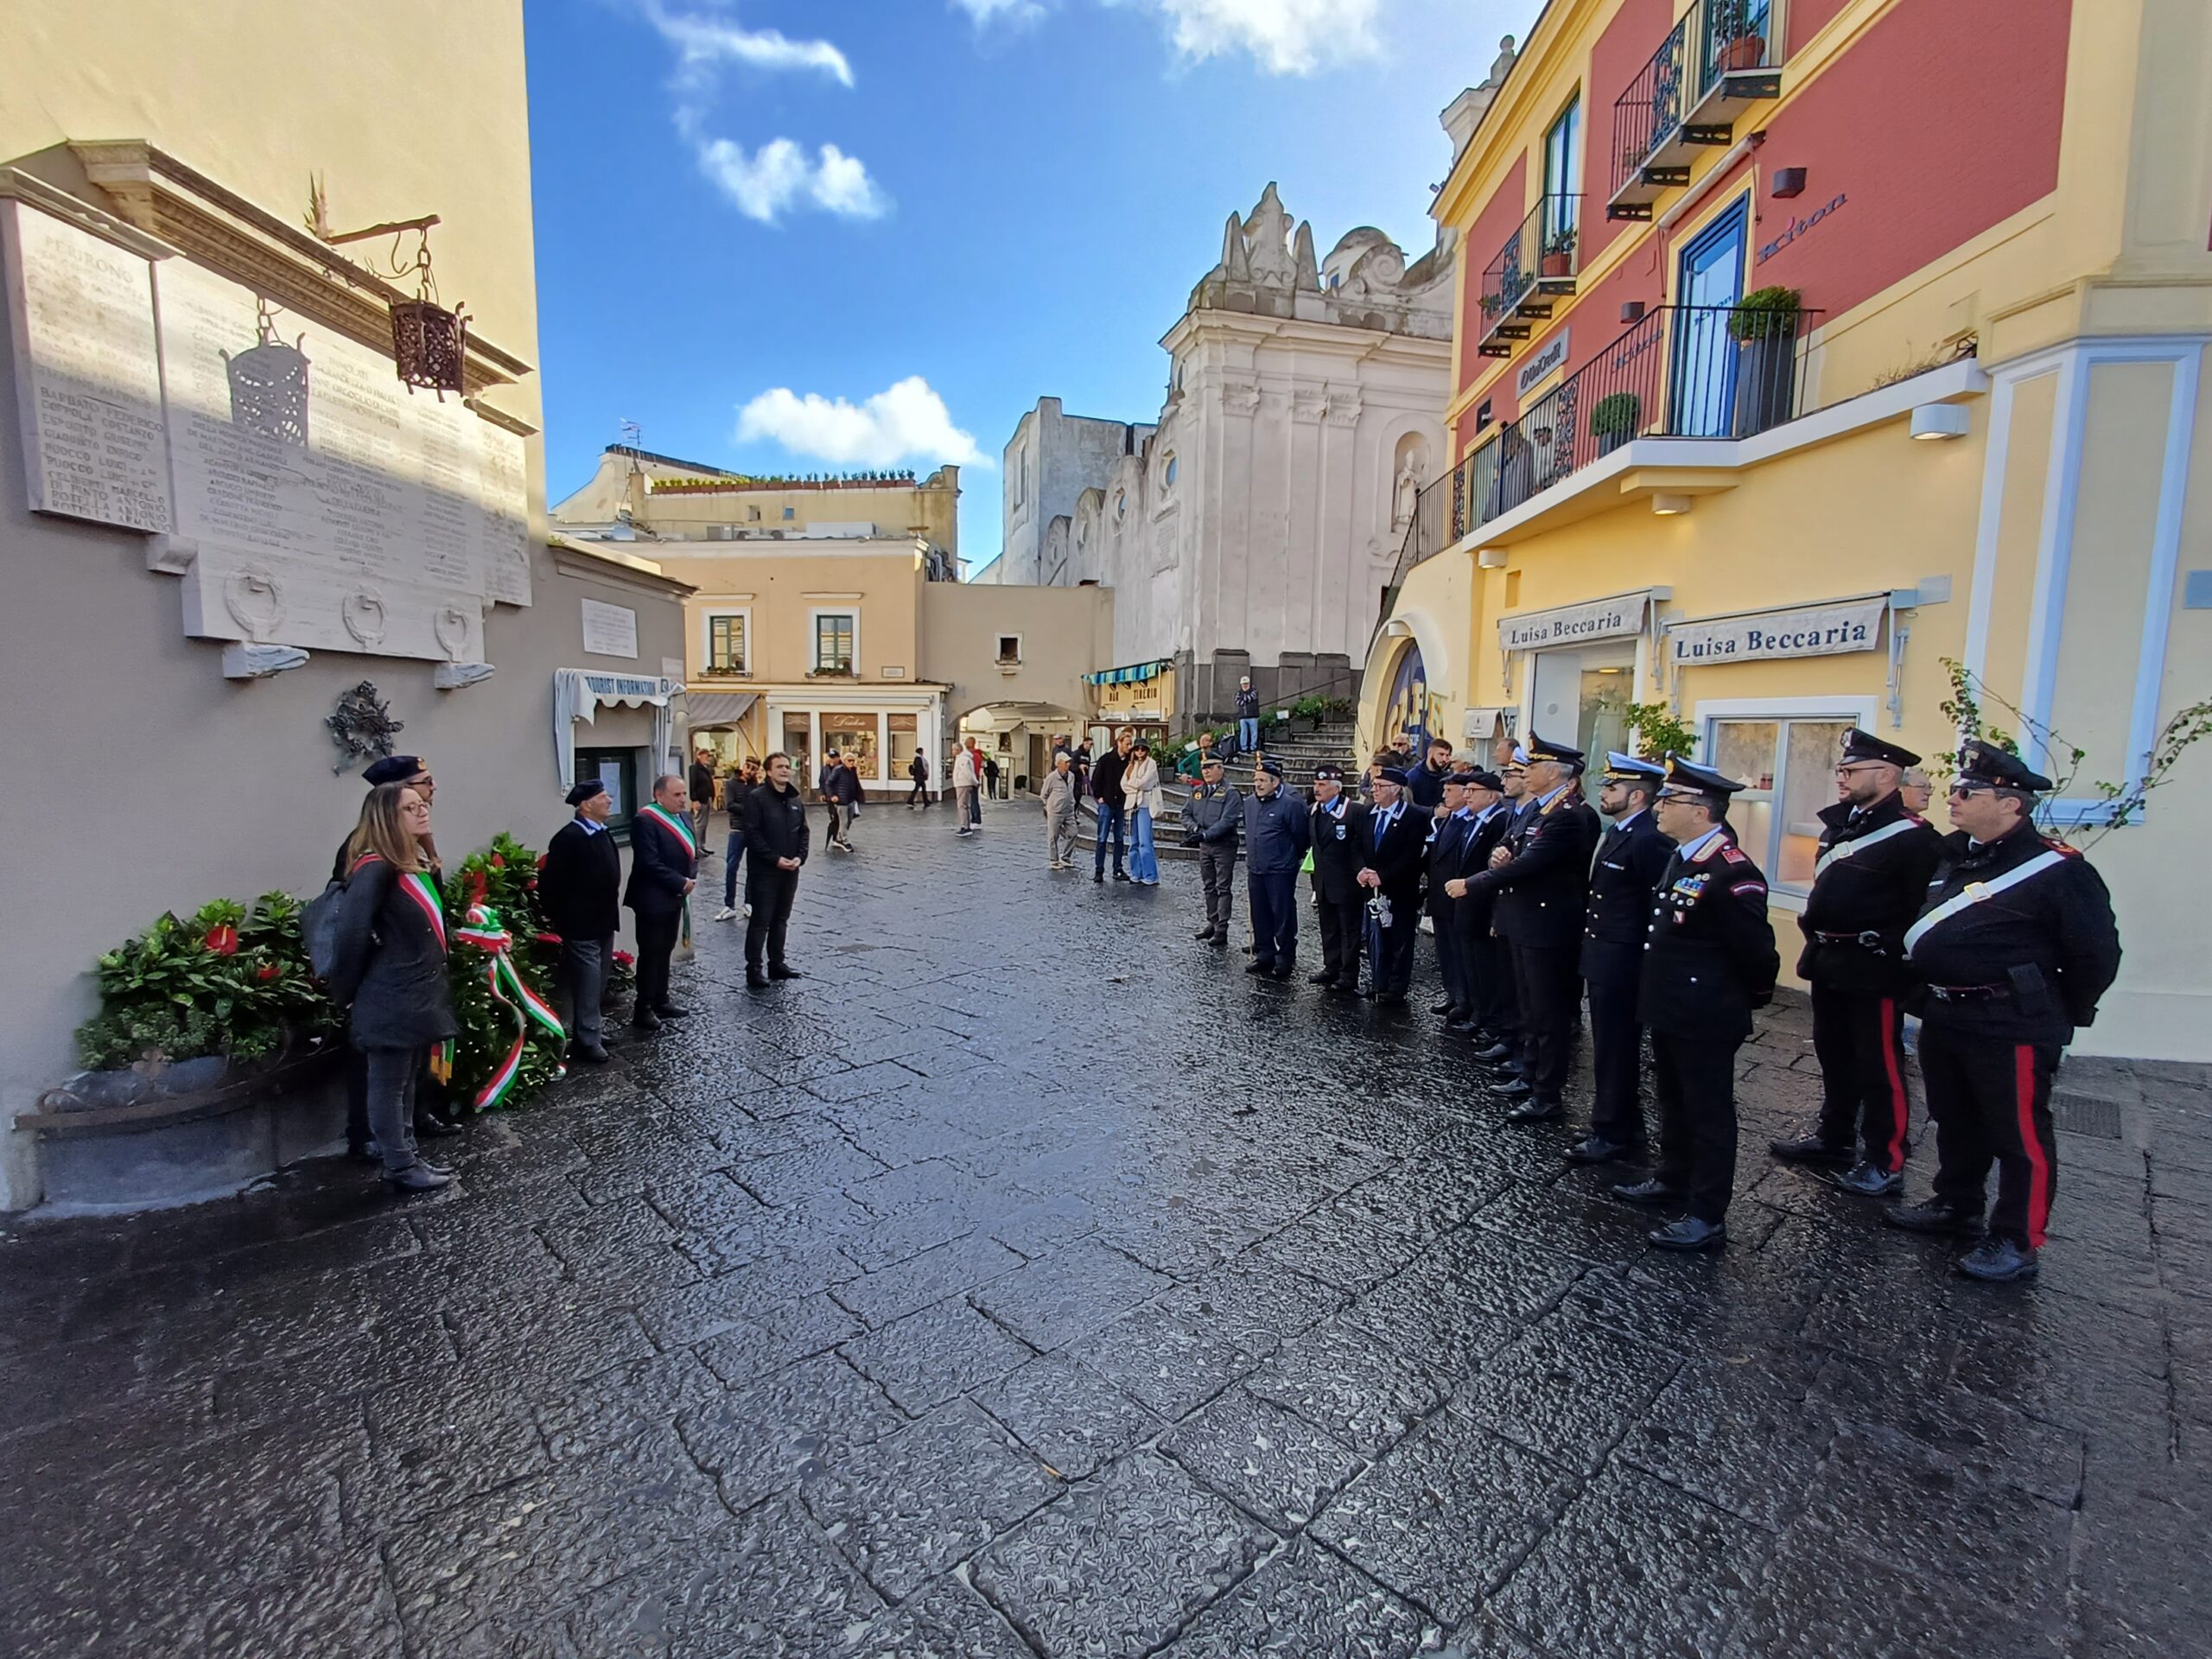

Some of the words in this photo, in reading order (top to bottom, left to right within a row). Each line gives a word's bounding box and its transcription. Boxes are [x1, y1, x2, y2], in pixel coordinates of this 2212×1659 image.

[1757, 193, 1847, 267] Kiton
[1529, 341, 1561, 382] UniCredit
[41, 387, 100, 413] BARBATO
[106, 408, 164, 433] FEDERICO
[41, 400, 93, 423] COPPOLA
[102, 417, 155, 441] COSTANZO
[41, 413, 97, 437] ESPOSITO
[104, 432, 149, 452] GIUSEPPE
[117, 496, 166, 513] ANTONIO
[118, 505, 167, 523] ANTONIO
[1510, 626, 1548, 645] Luisa
[1553, 612, 1622, 638] Beccaria
[1676, 637, 1736, 658] Luisa
[1747, 620, 1866, 651] Beccaria
[616, 677, 657, 697] INFORMATION
[1134, 688, 1158, 701] TIBERIO
